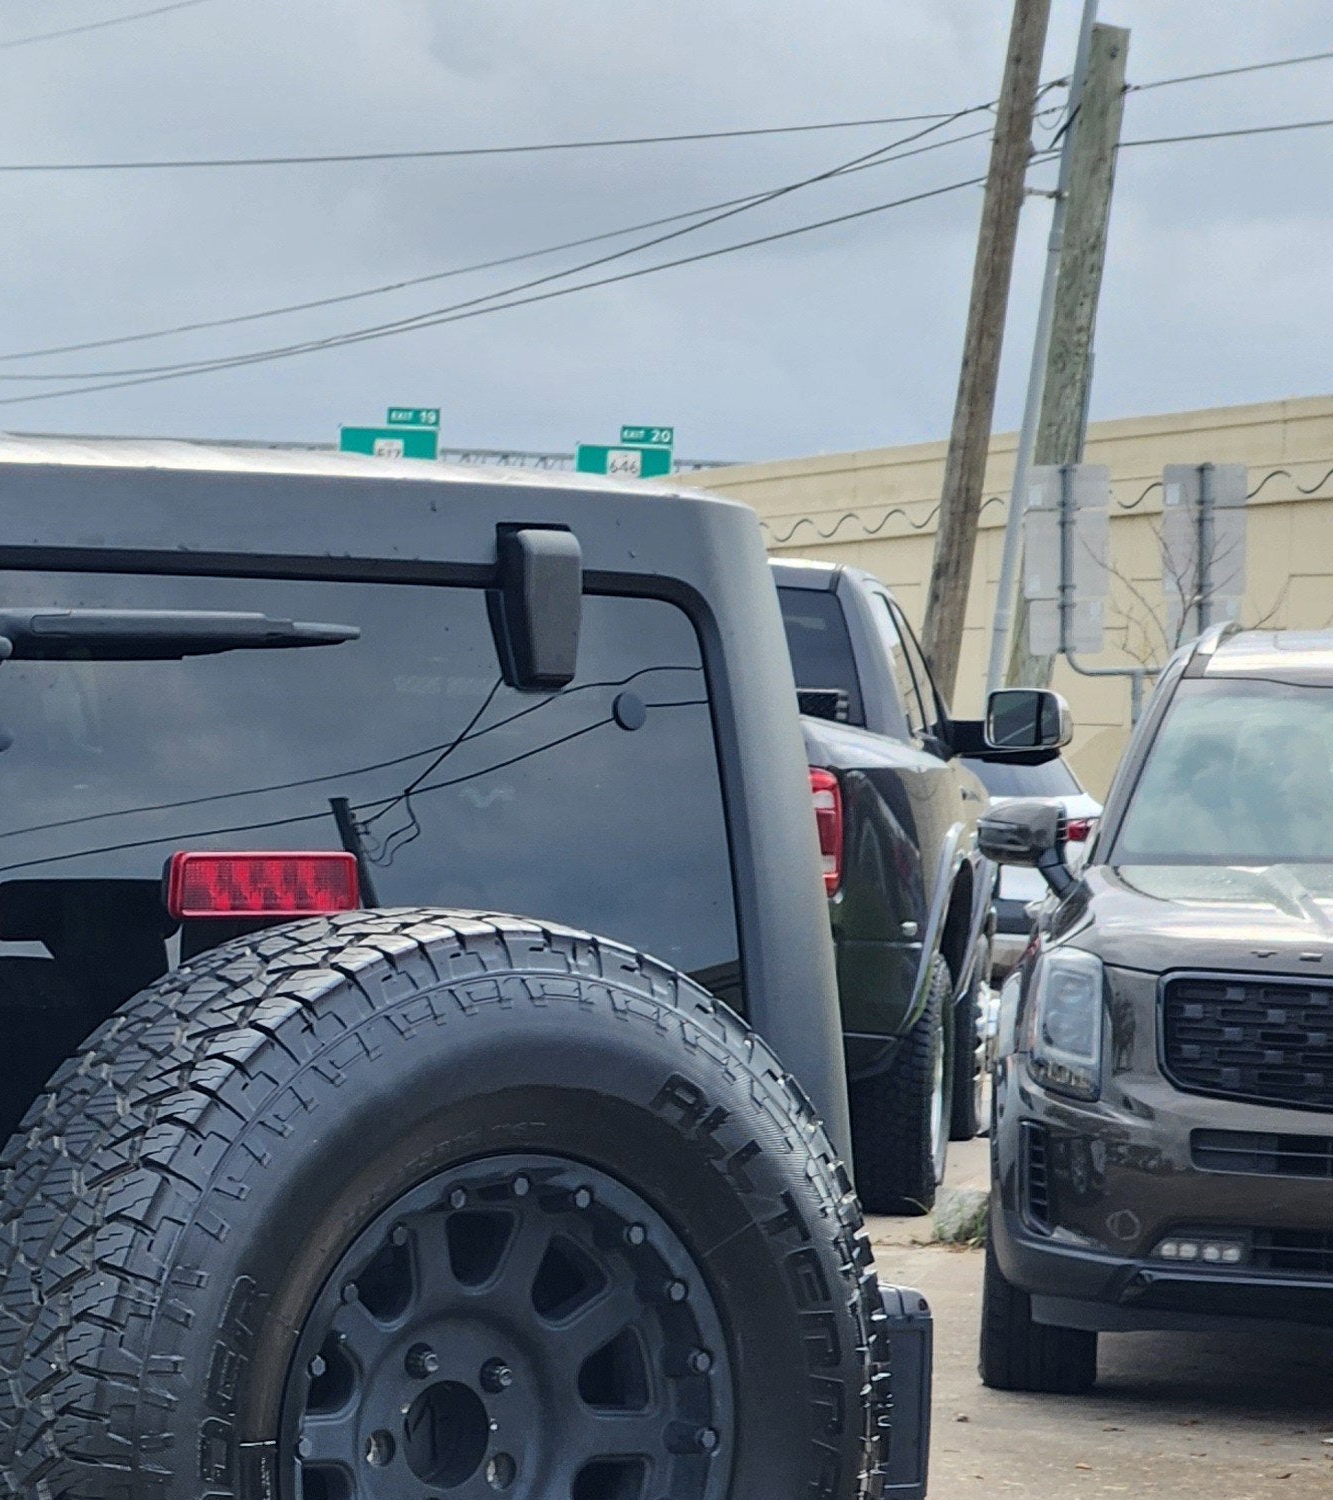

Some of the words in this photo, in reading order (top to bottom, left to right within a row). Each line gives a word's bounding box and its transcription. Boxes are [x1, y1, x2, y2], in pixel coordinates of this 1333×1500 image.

[390, 410, 414, 421] EXIT
[420, 410, 437, 425] 19
[623, 429, 645, 440] EXIT
[651, 429, 671, 443] 20
[610, 459, 639, 475] 646
[648, 1072, 763, 1196] ALL
